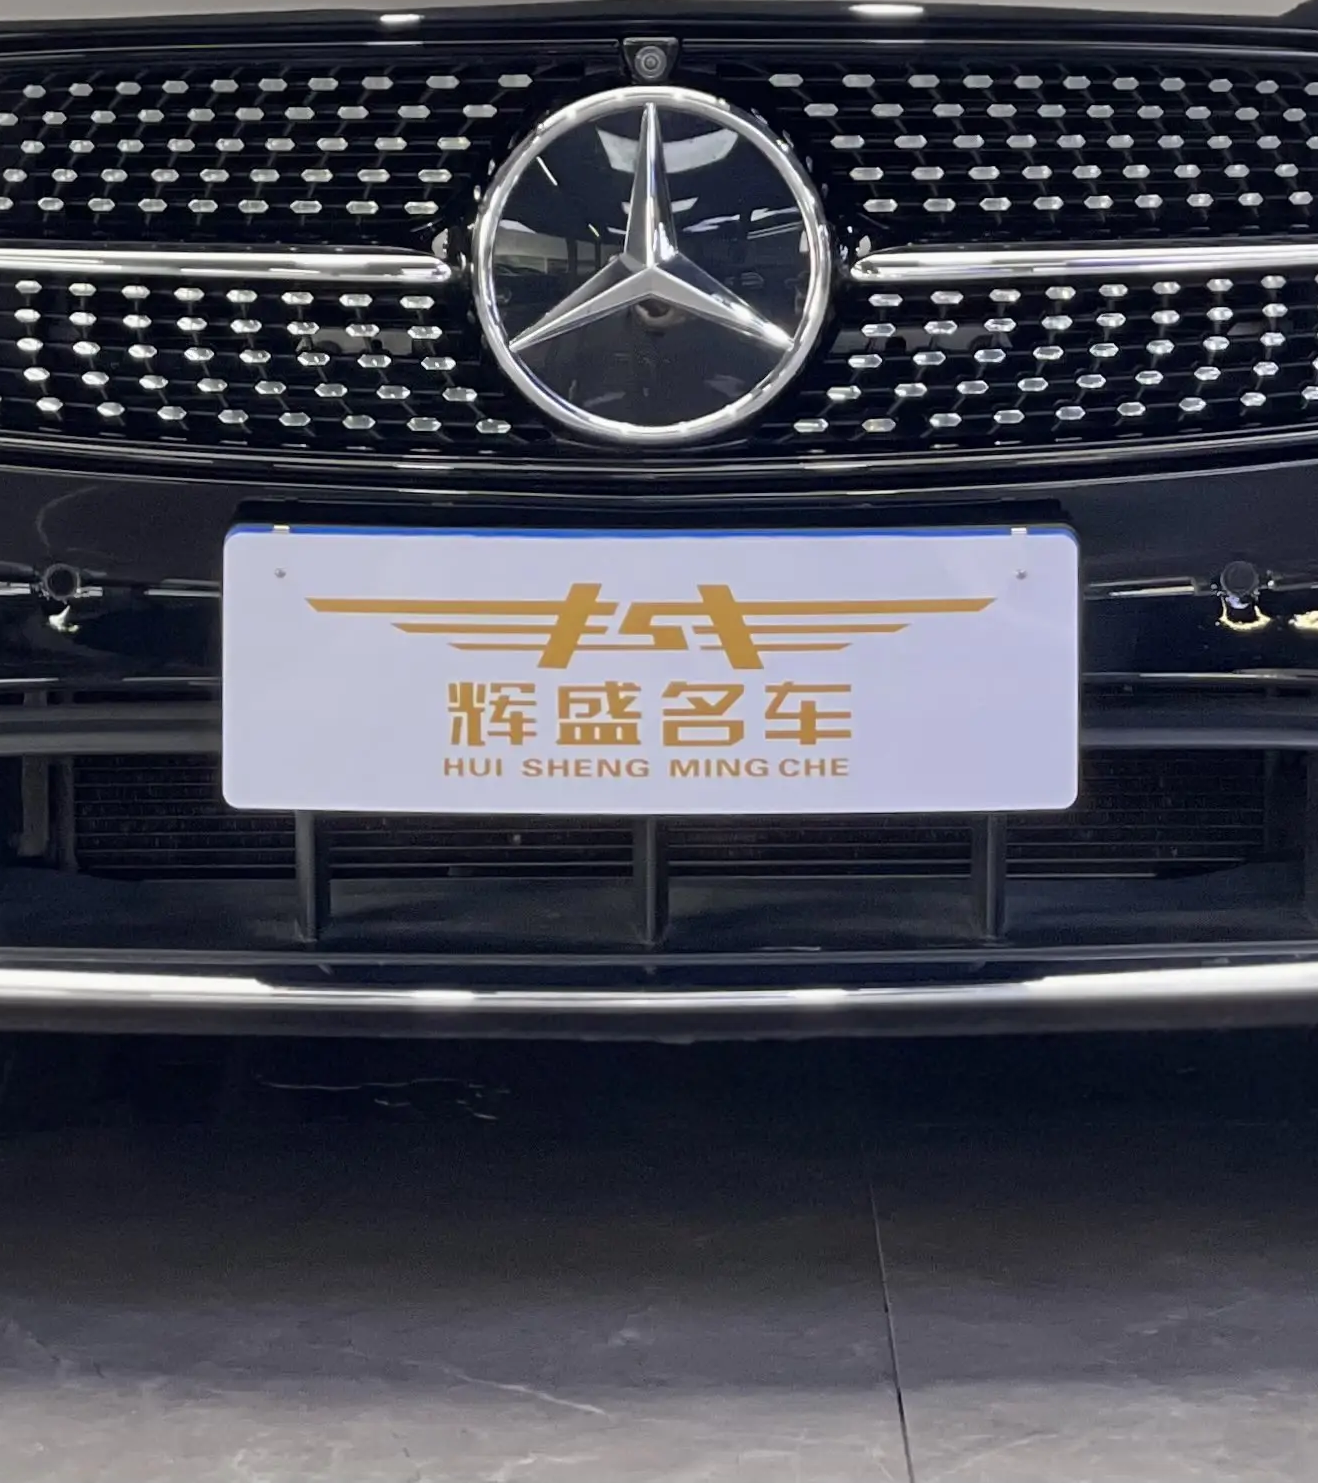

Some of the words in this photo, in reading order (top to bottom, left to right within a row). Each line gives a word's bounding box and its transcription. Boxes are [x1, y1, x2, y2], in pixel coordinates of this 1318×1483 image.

[447, 680, 853, 748] 辉盛名车
[443, 757, 504, 778] HUI
[521, 758, 651, 778] SHENG
[669, 758, 770, 778] MING
[778, 757, 850, 777] CHE
